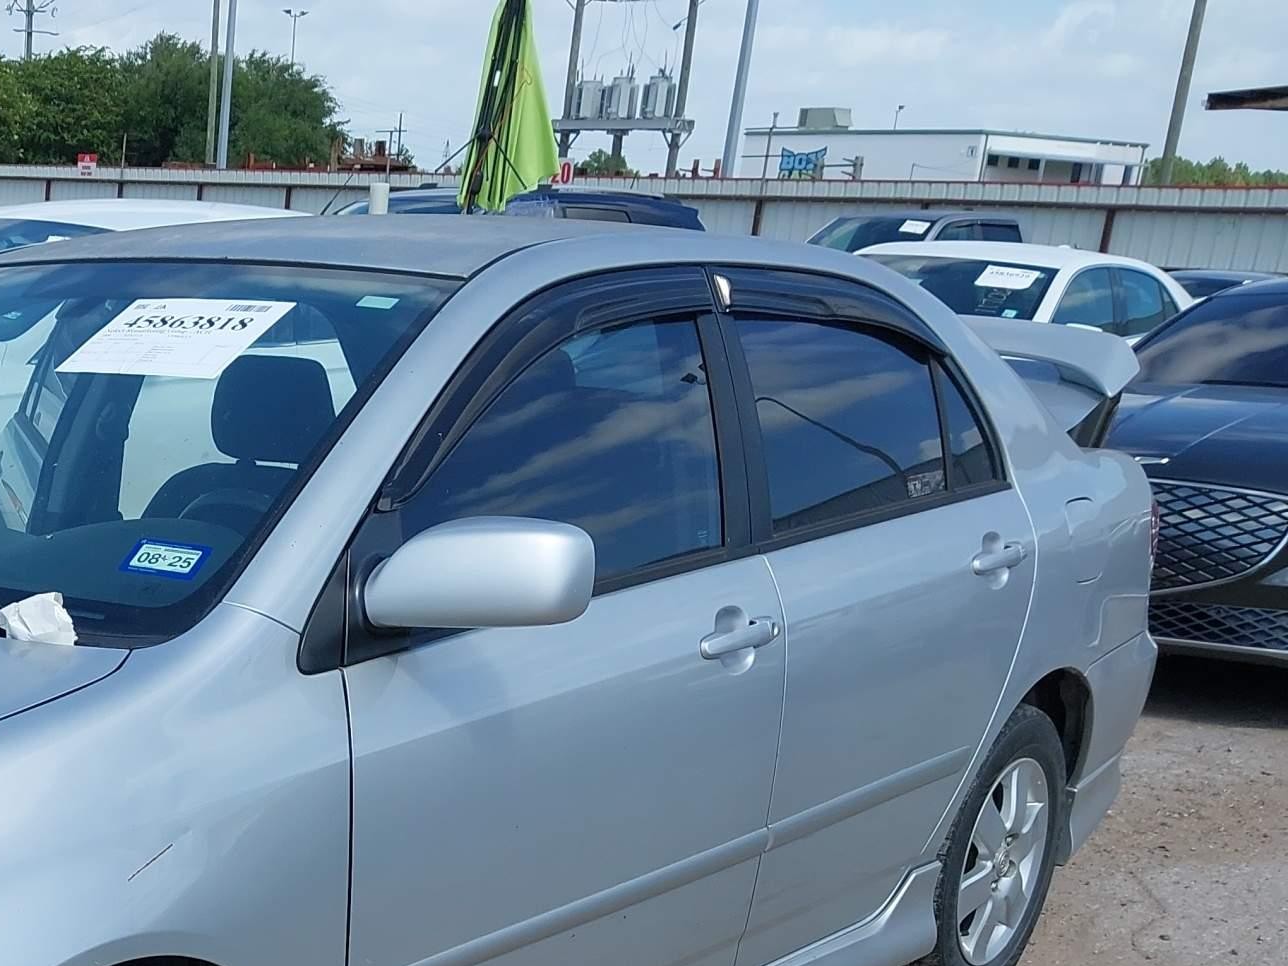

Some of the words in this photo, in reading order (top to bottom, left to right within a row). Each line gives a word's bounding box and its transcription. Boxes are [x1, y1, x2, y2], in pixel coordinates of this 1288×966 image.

[122, 314, 256, 332] 45863818
[137, 551, 162, 565] 08
[167, 555, 195, 569] 25
